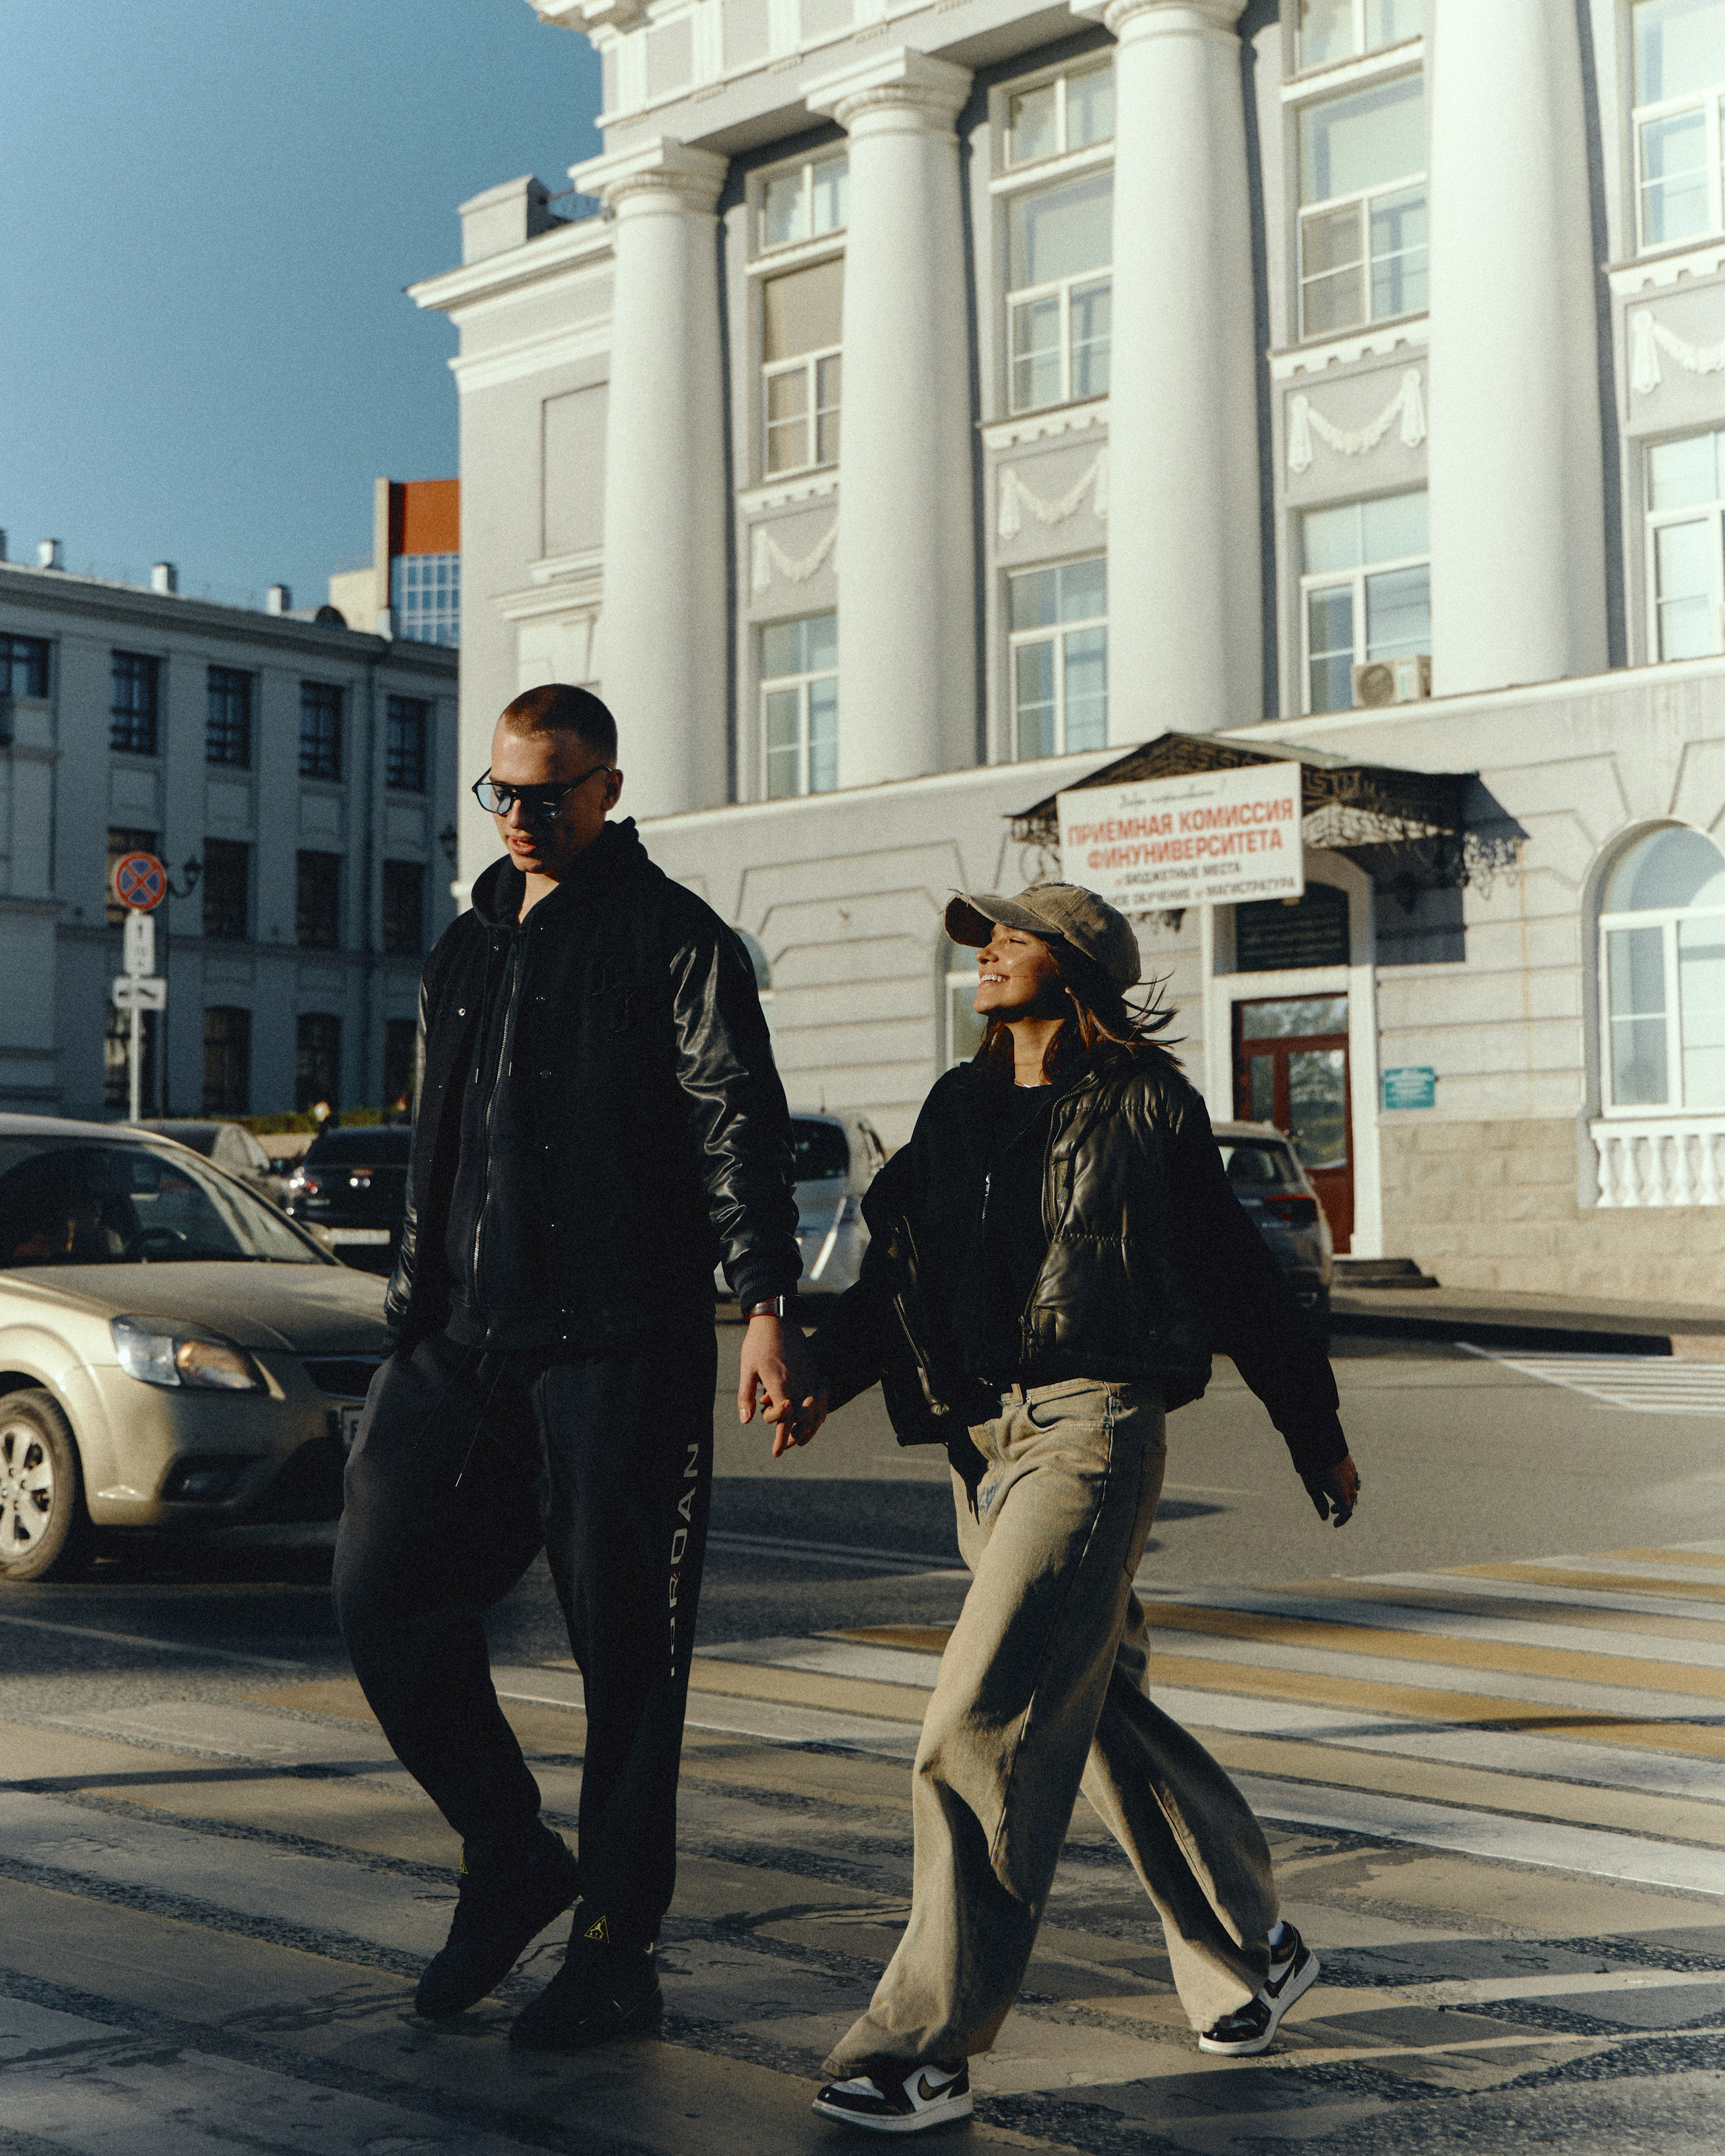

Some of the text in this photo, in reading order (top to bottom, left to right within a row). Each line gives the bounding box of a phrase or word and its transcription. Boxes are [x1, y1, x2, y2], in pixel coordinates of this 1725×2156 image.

[1068, 798, 1293, 846] ПРИЁМНАЯ КОМИССИЯ
[1088, 828, 1283, 870] ФИНУНИВЕРСИТЕТА
[669, 1442, 699, 1677] ORDAN
